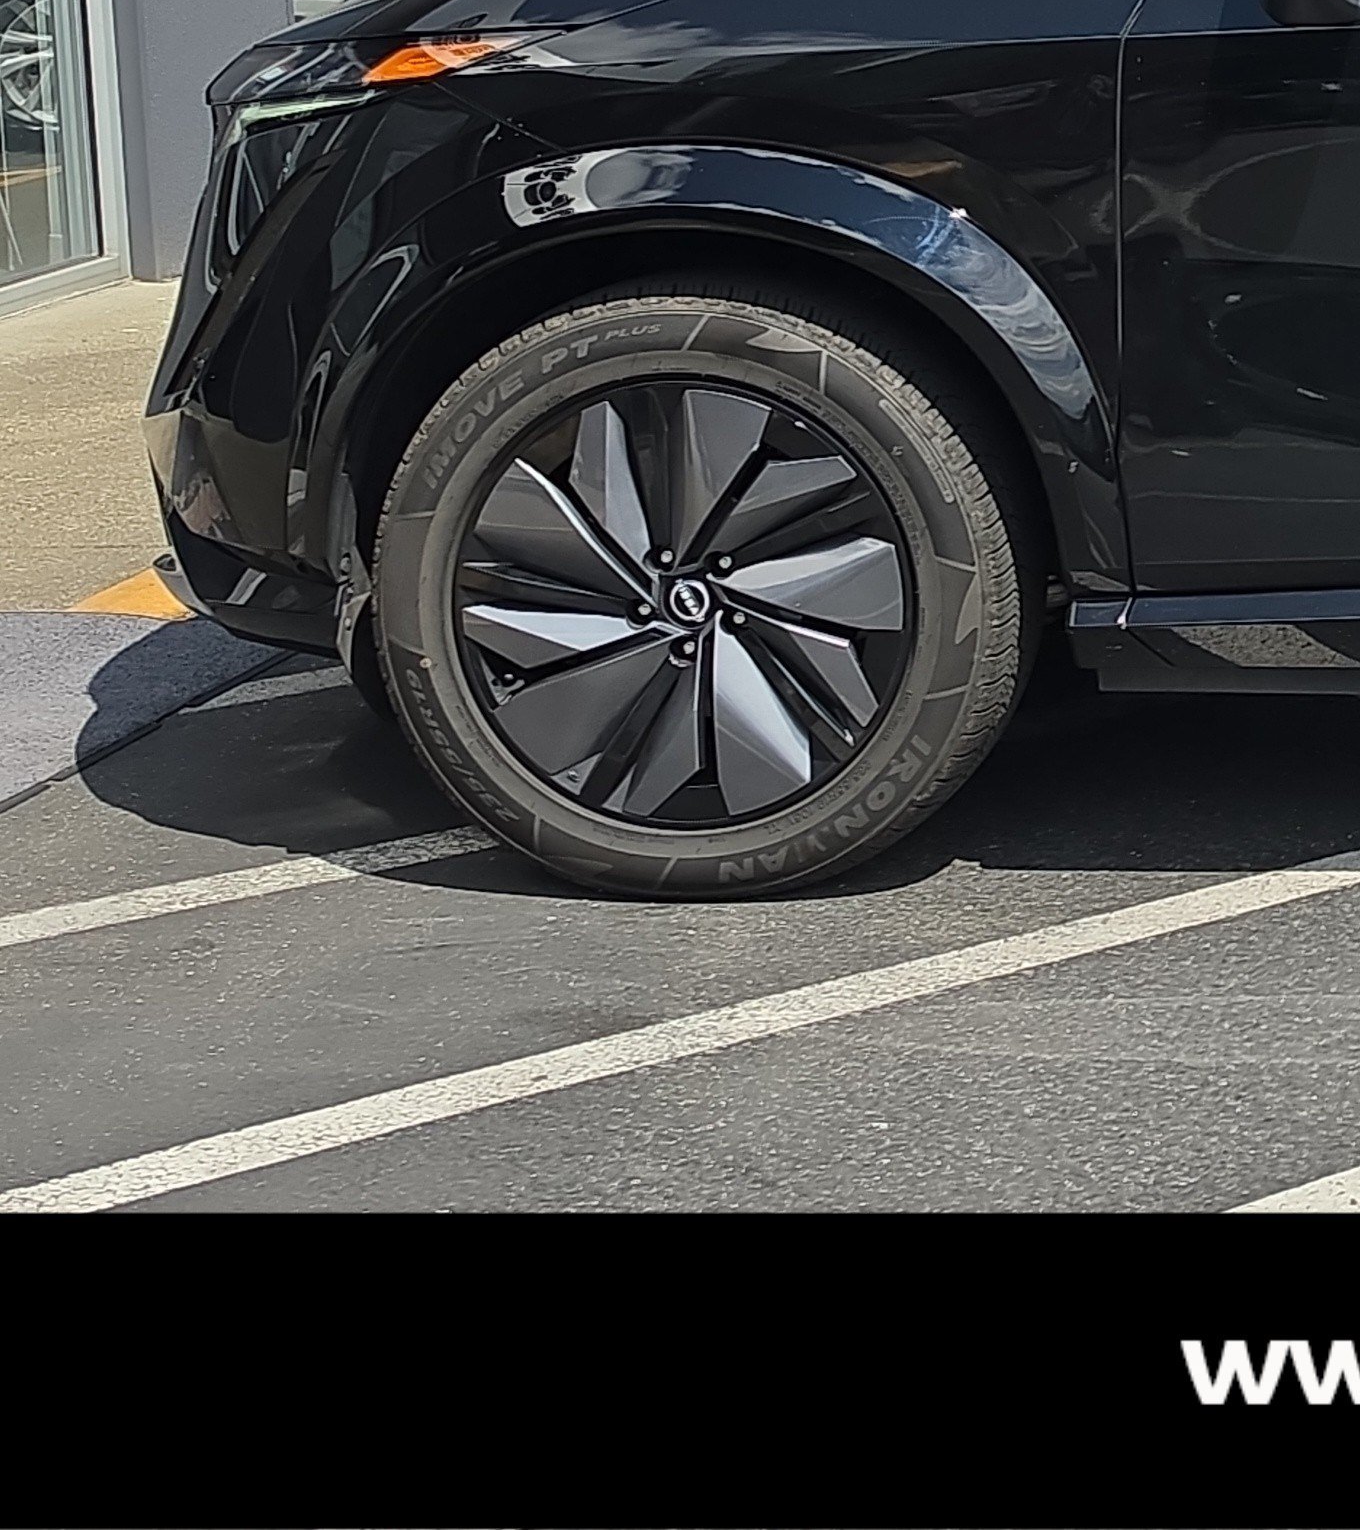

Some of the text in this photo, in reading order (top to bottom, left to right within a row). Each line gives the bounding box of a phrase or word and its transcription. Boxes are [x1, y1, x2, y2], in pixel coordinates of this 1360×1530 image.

[541, 335, 599, 375] PT
[603, 323, 662, 342] PLUS
[406, 668, 520, 822] 235/55R19
